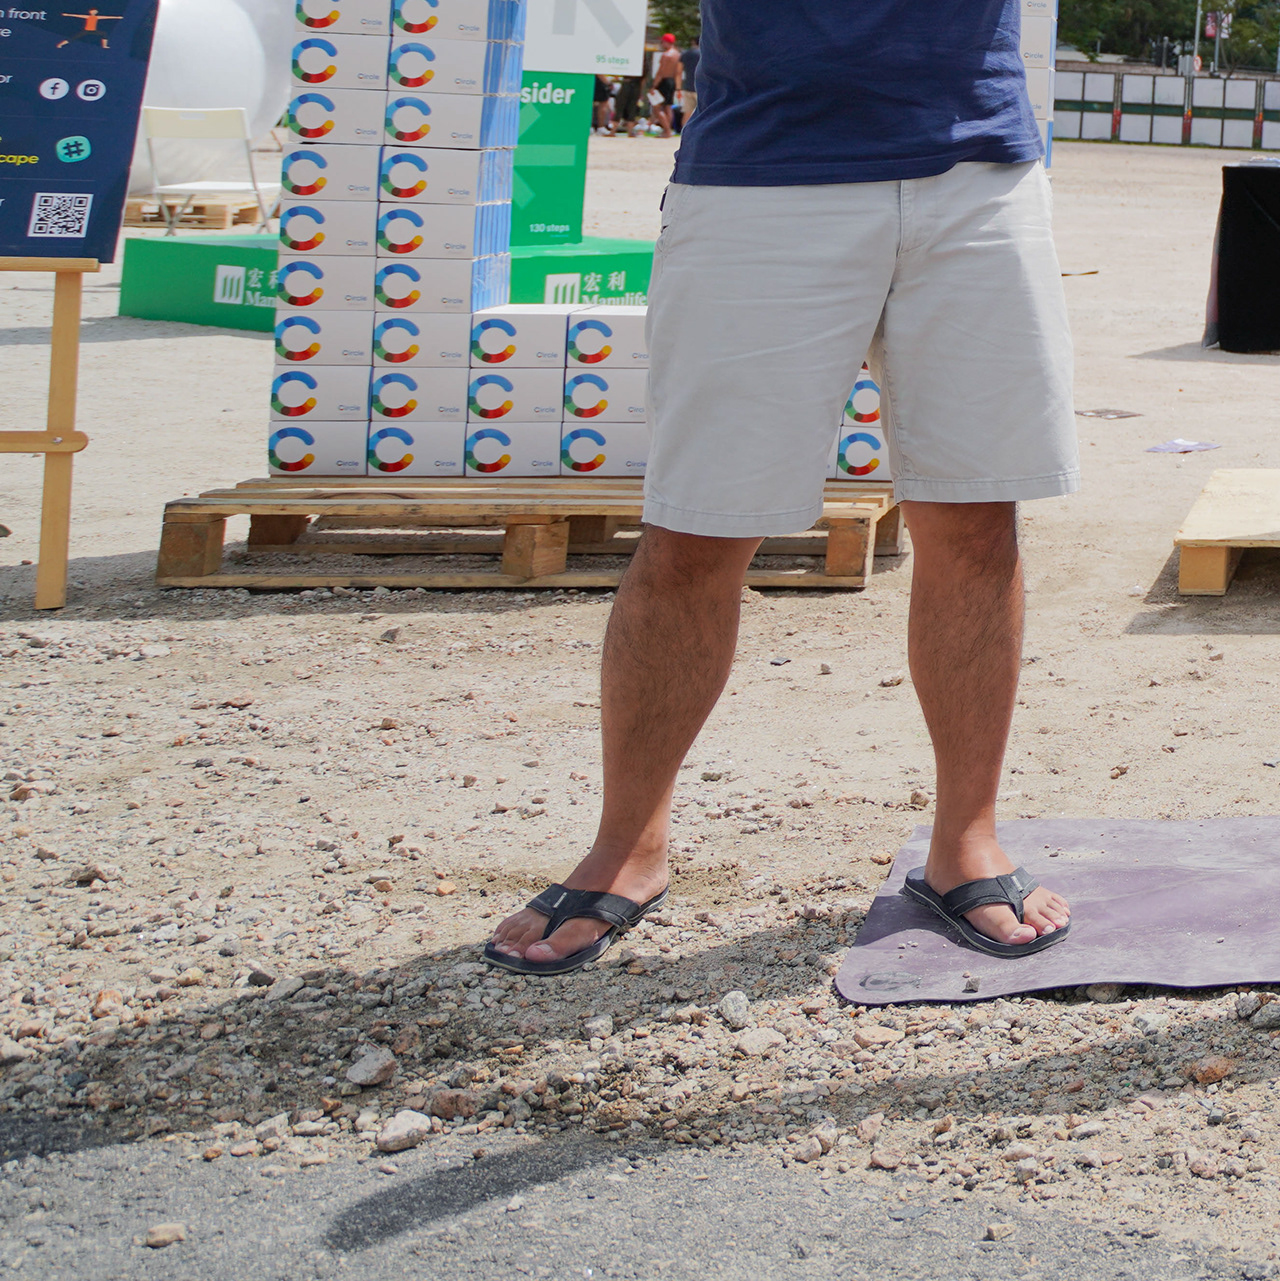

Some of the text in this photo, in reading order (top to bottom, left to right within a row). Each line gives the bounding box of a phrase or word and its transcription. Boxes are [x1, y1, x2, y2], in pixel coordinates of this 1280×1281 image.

[8, 7, 47, 21] front
[596, 54, 630, 67] 95 steps
[520, 82, 576, 105] sider
[529, 222, 571, 235] 130 steps
[583, 271, 627, 293] 宏利
